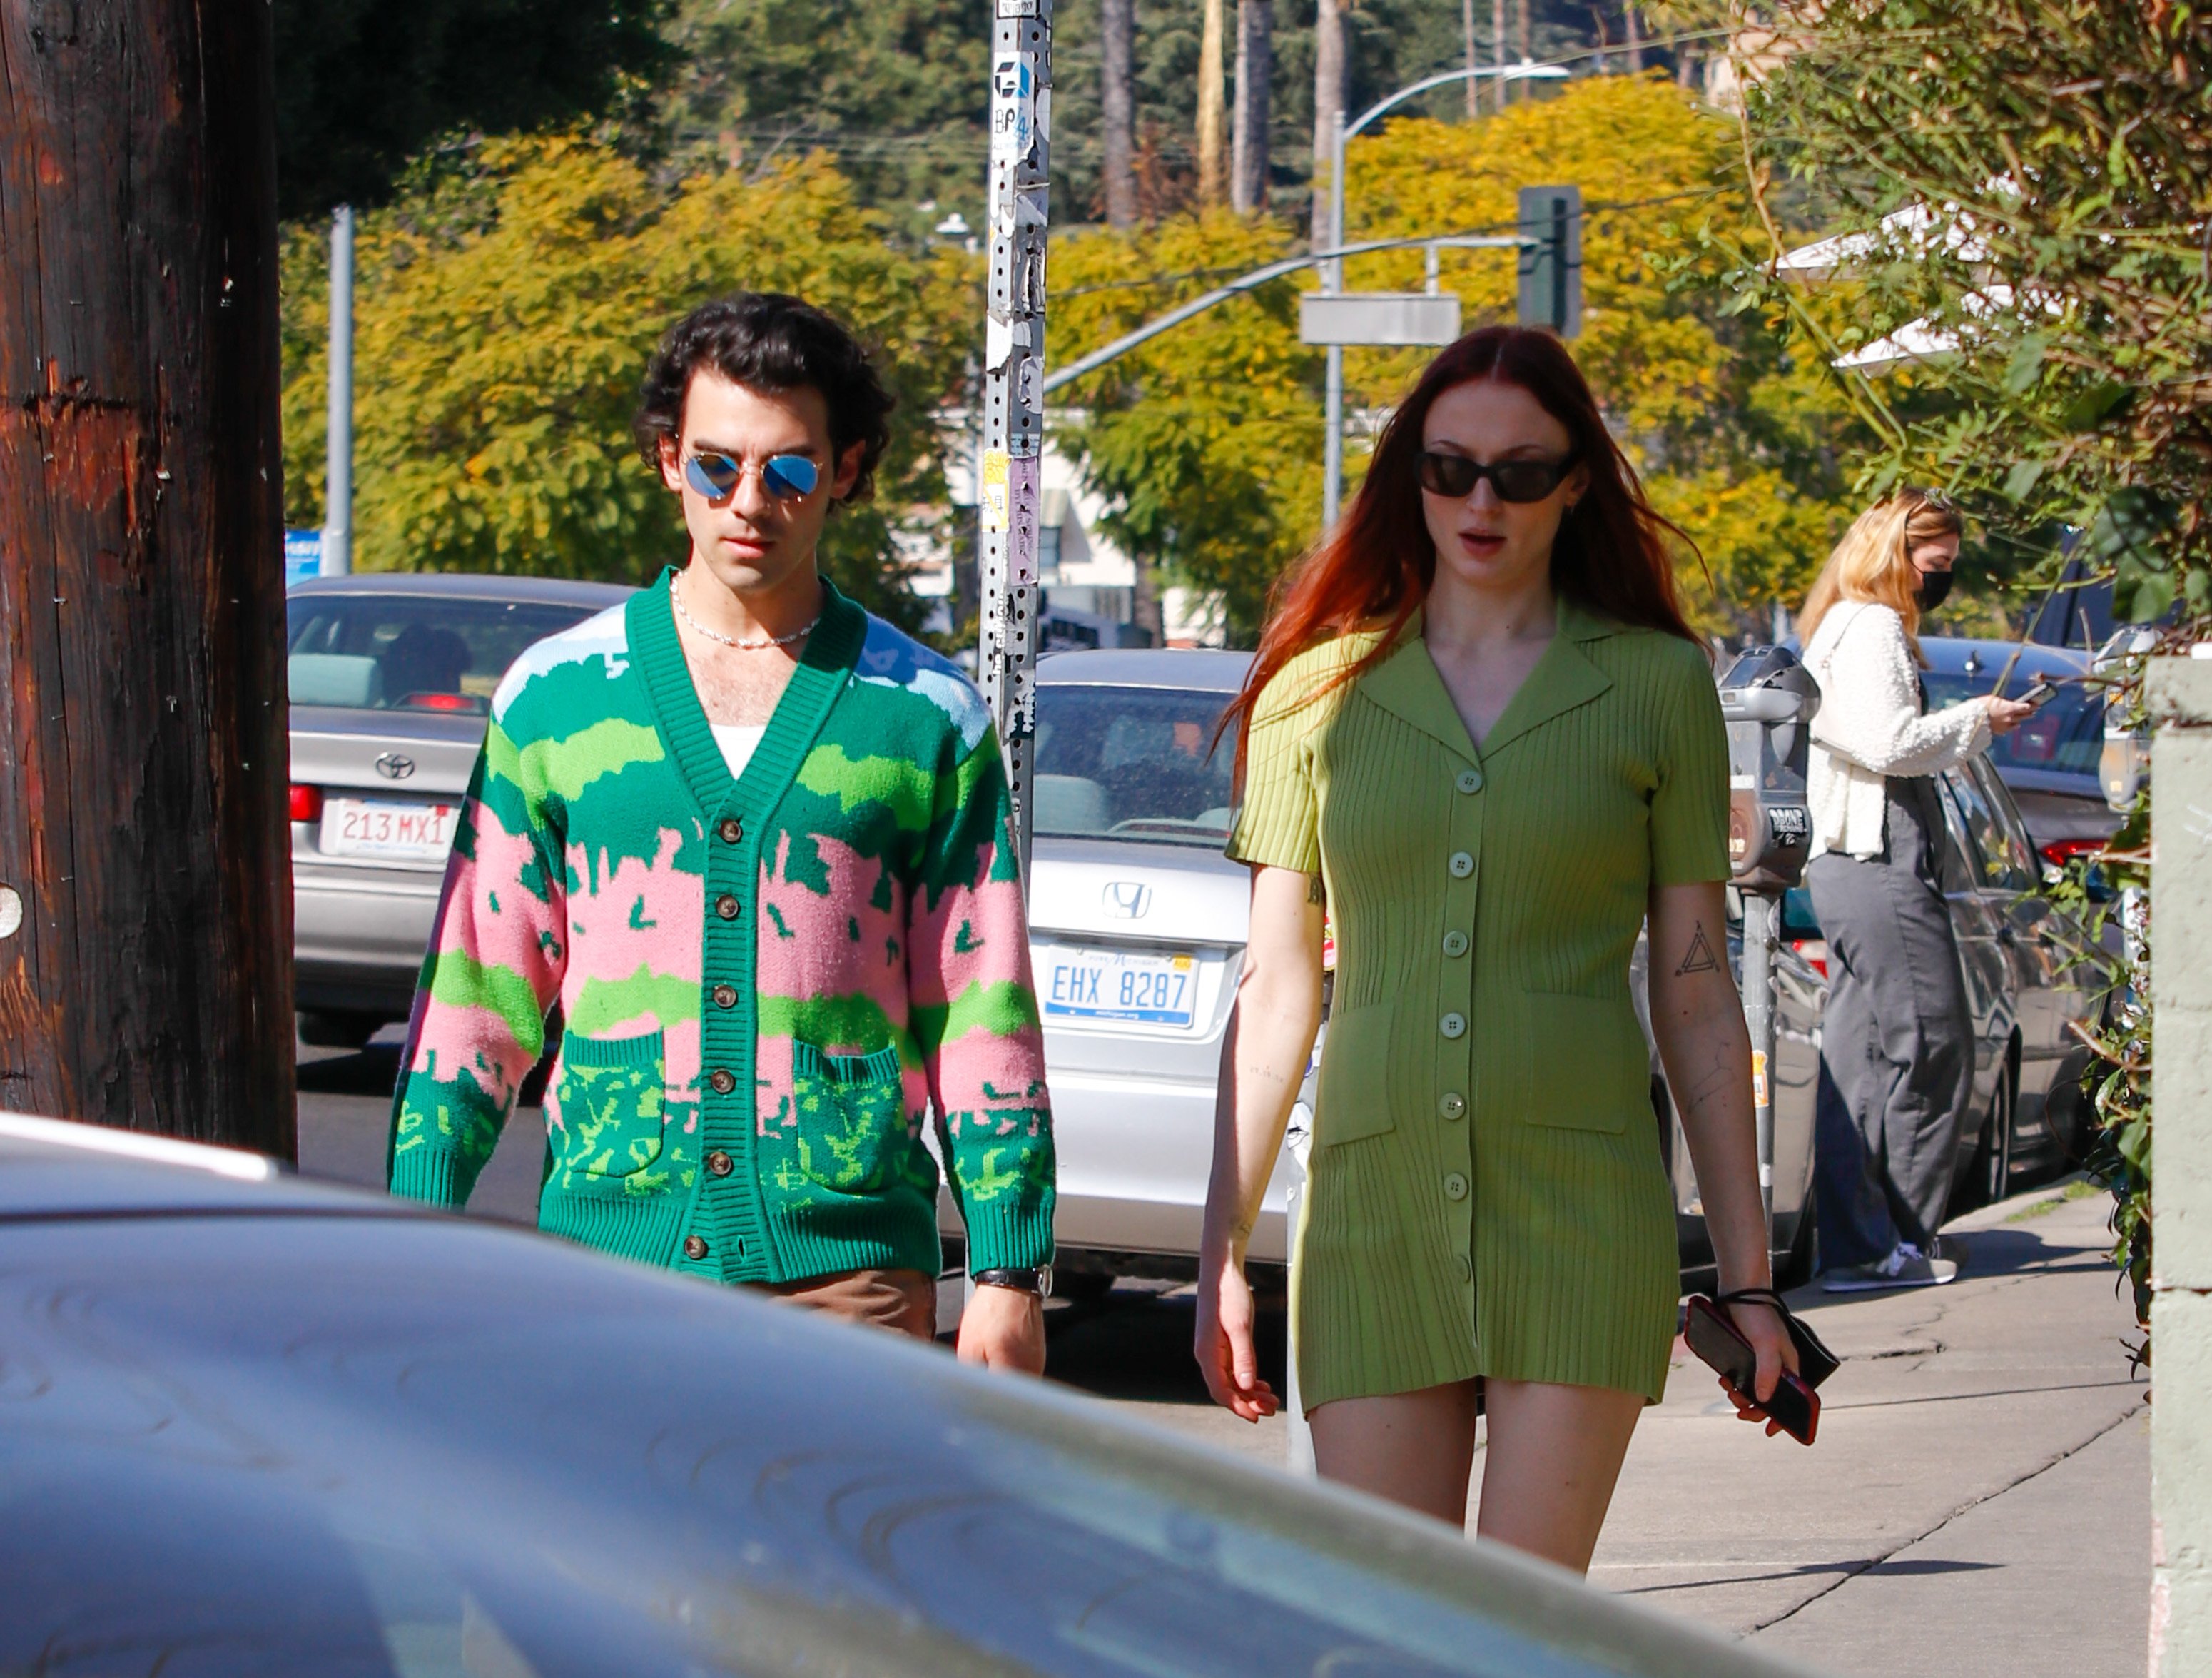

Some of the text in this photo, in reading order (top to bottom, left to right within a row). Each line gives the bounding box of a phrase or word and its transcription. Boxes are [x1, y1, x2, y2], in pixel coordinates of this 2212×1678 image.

[343, 811, 393, 841] 213
[1052, 965, 1187, 1009] EHX 8287
